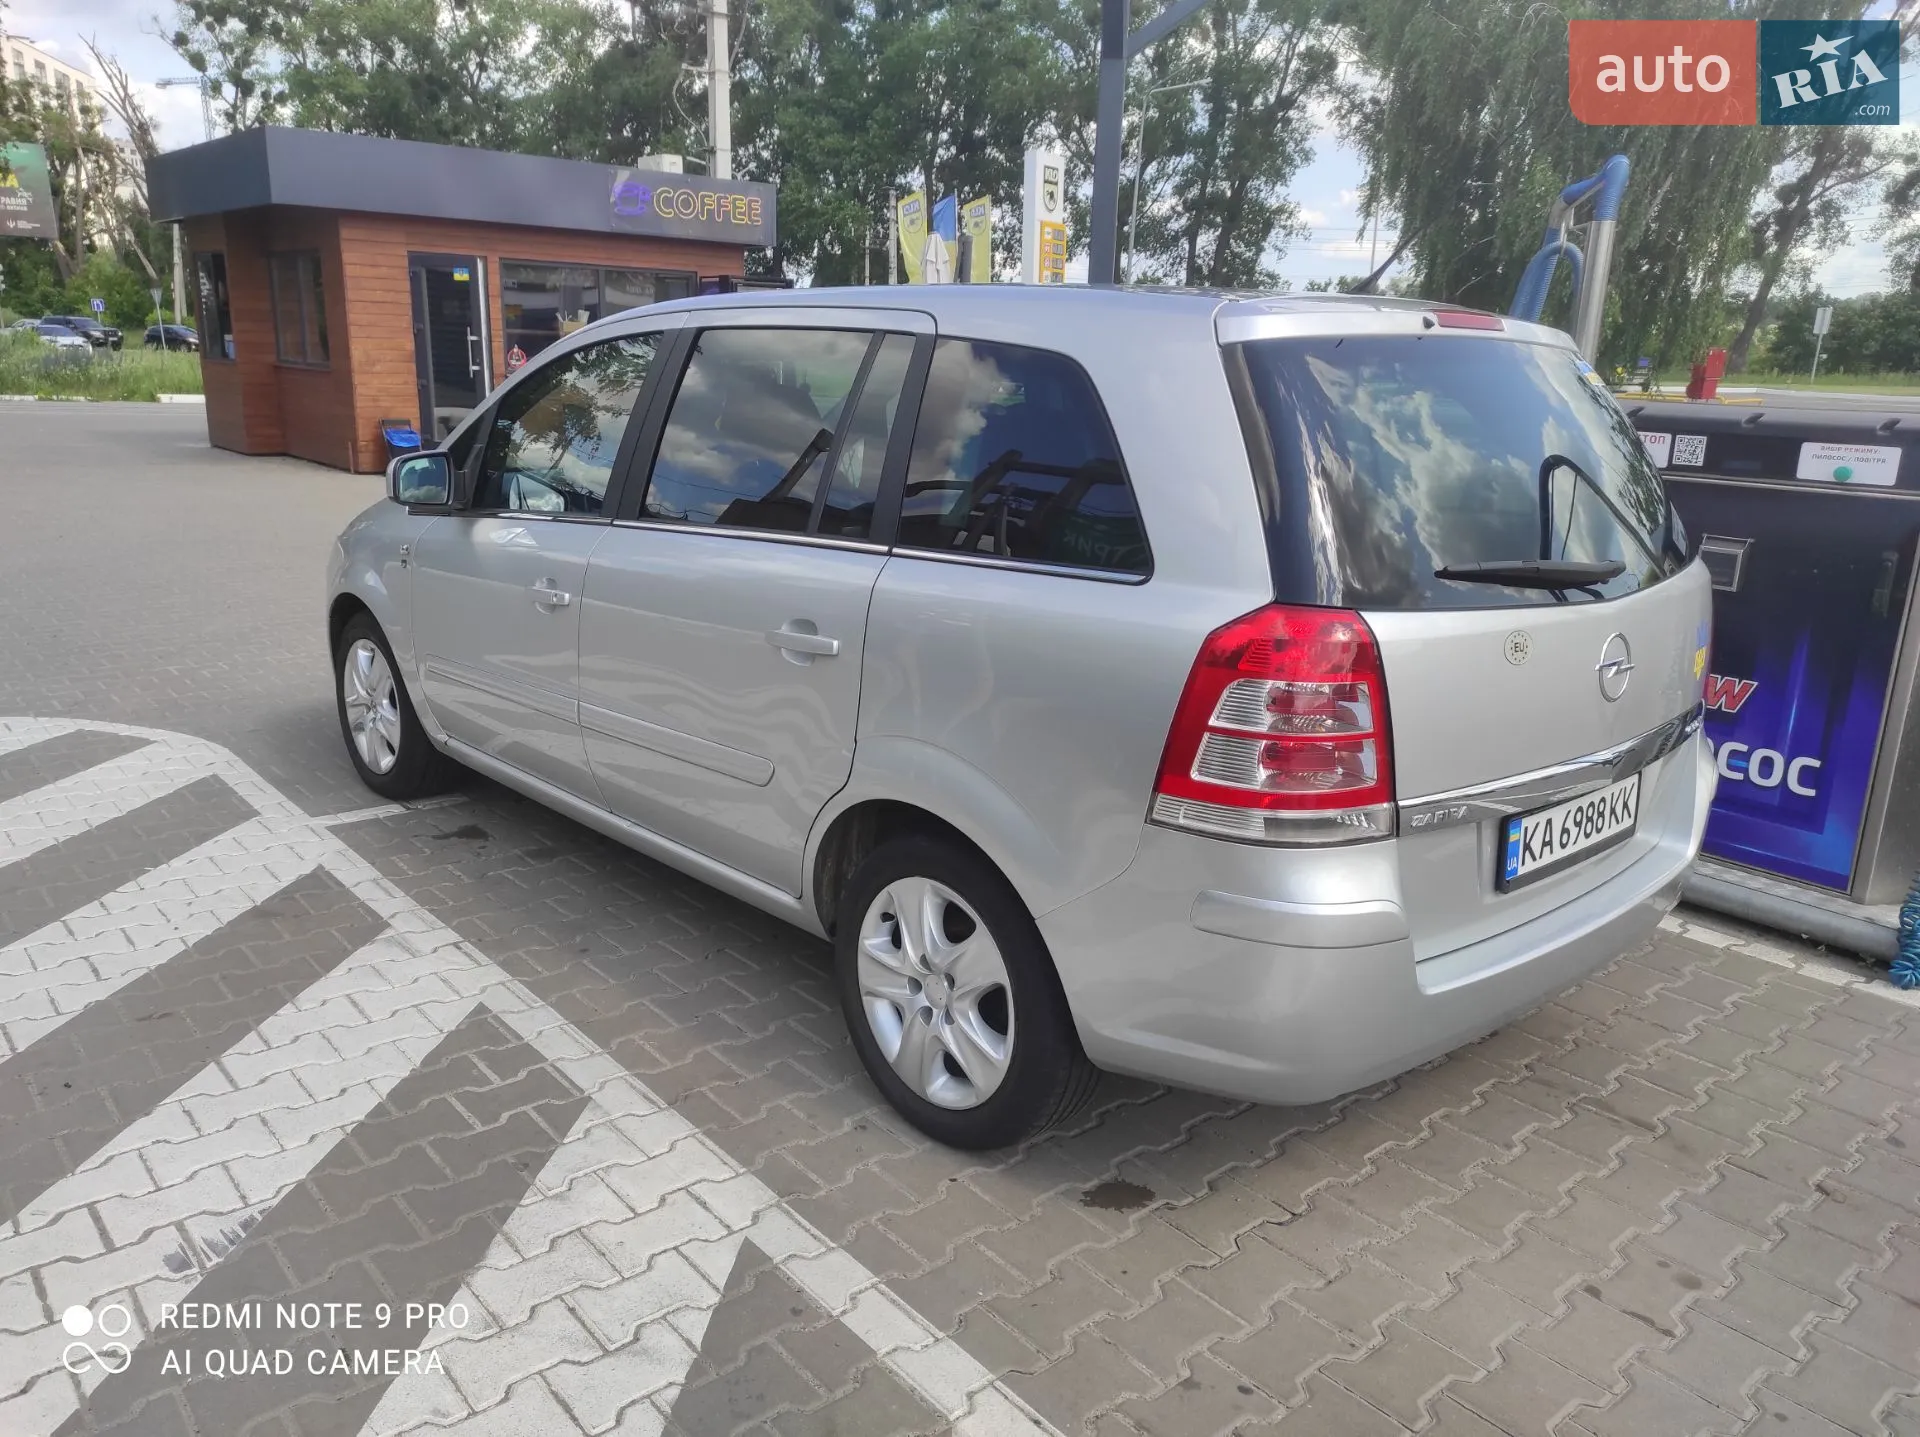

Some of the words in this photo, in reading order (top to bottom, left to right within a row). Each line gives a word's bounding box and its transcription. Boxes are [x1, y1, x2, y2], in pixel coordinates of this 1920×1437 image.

[654, 187, 761, 225] COFFEE
[1811, 453, 1846, 461] ПИЛОСОС
[1514, 642, 1525, 653] EU
[1708, 737, 1821, 797] СОС
[1506, 857, 1518, 871] UA
